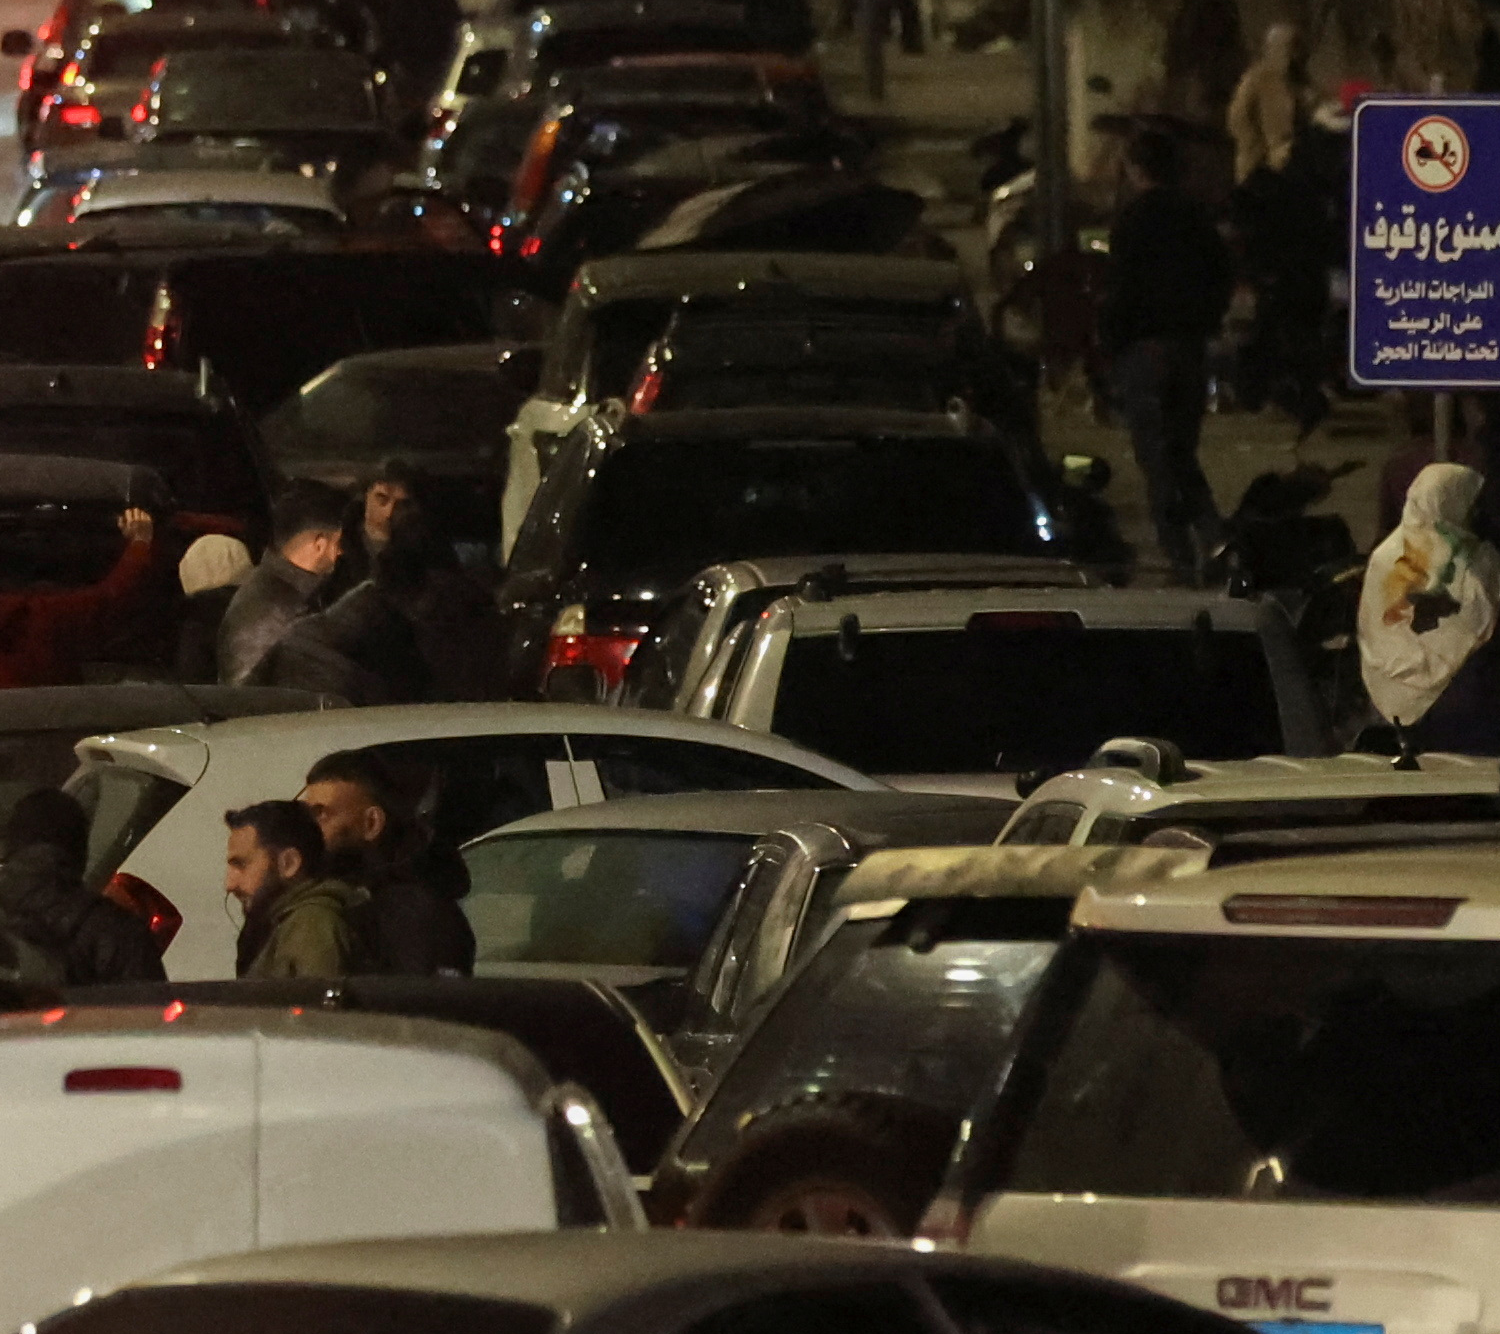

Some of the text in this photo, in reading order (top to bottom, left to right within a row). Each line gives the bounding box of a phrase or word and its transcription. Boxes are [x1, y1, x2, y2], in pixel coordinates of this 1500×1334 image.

[1363, 201, 1431, 261] وقوف
[1375, 279, 1494, 306] الدراجات النارية
[1388, 310, 1483, 335] على الرصيف
[1372, 338, 1499, 365] تحت طائلة الحجز
[1217, 1276, 1334, 1311] GMC
